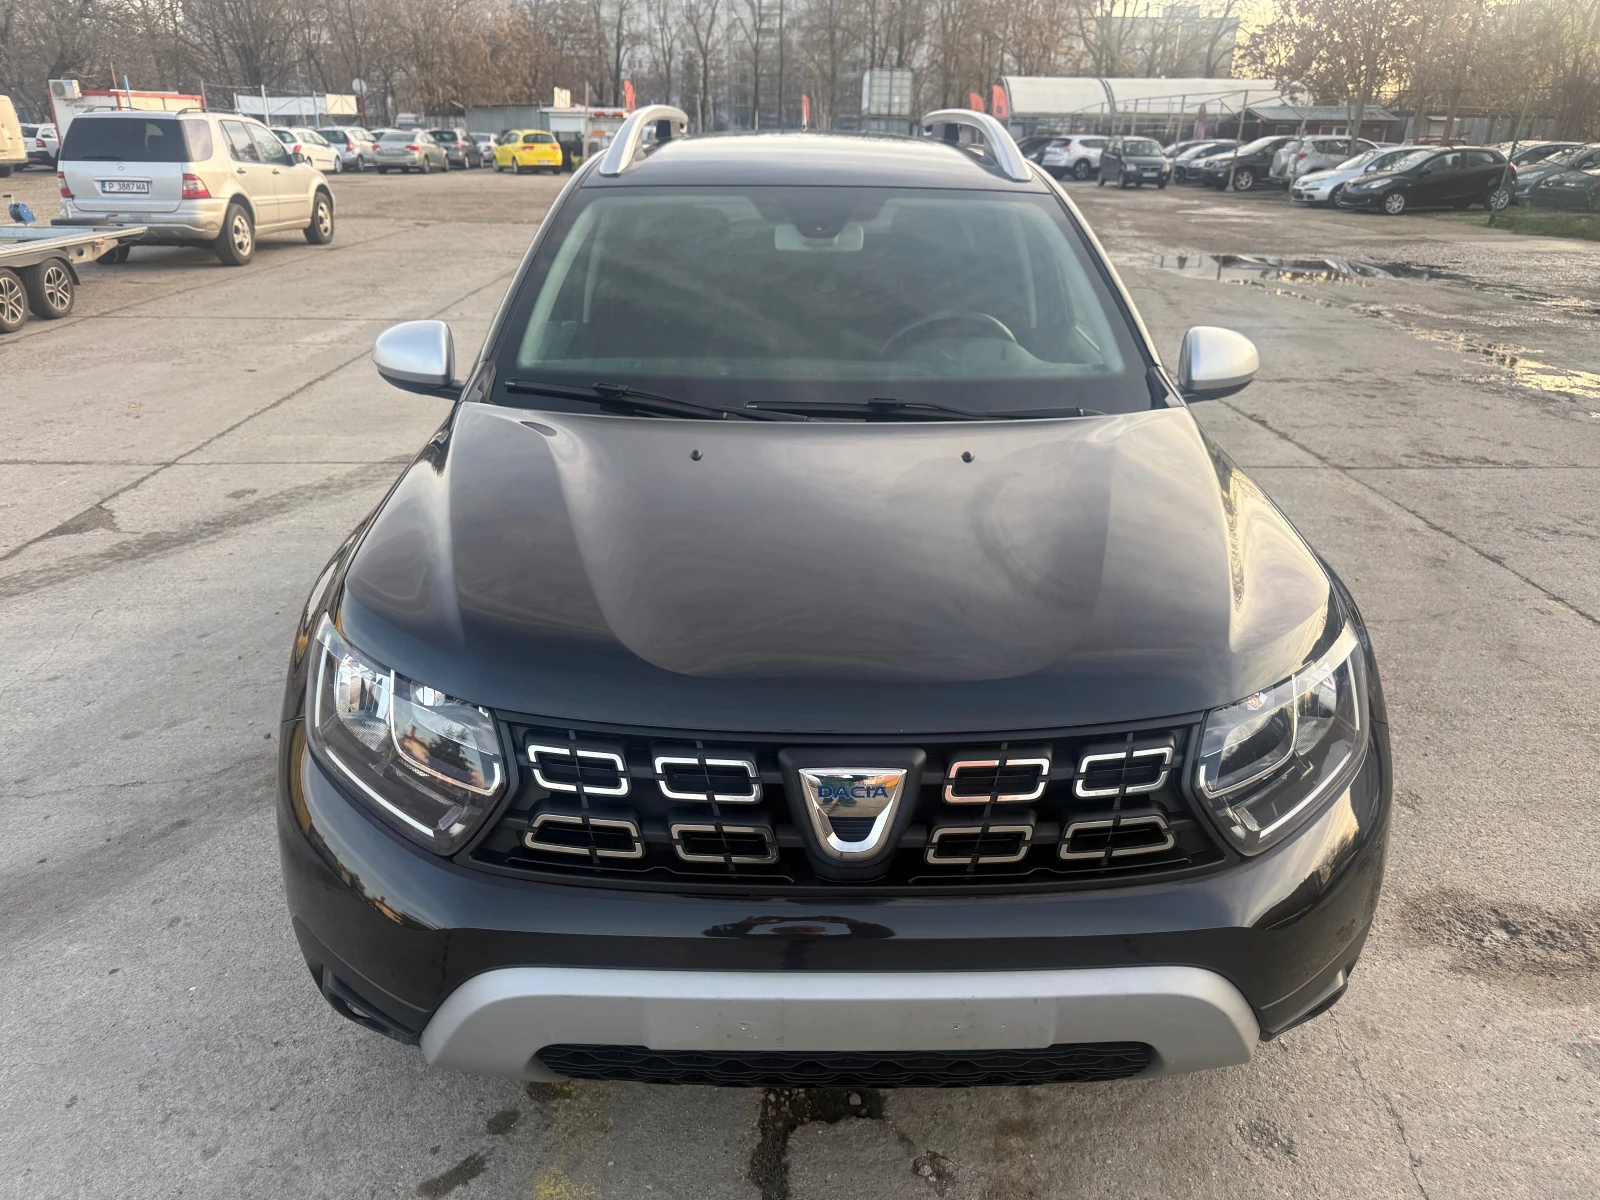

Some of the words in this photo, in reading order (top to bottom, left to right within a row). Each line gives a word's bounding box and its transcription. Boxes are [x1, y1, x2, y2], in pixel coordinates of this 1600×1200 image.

[108, 182, 114, 191] P
[117, 182, 135, 191] 3887
[136, 182, 146, 191] MA
[817, 785, 889, 799] DACIA
